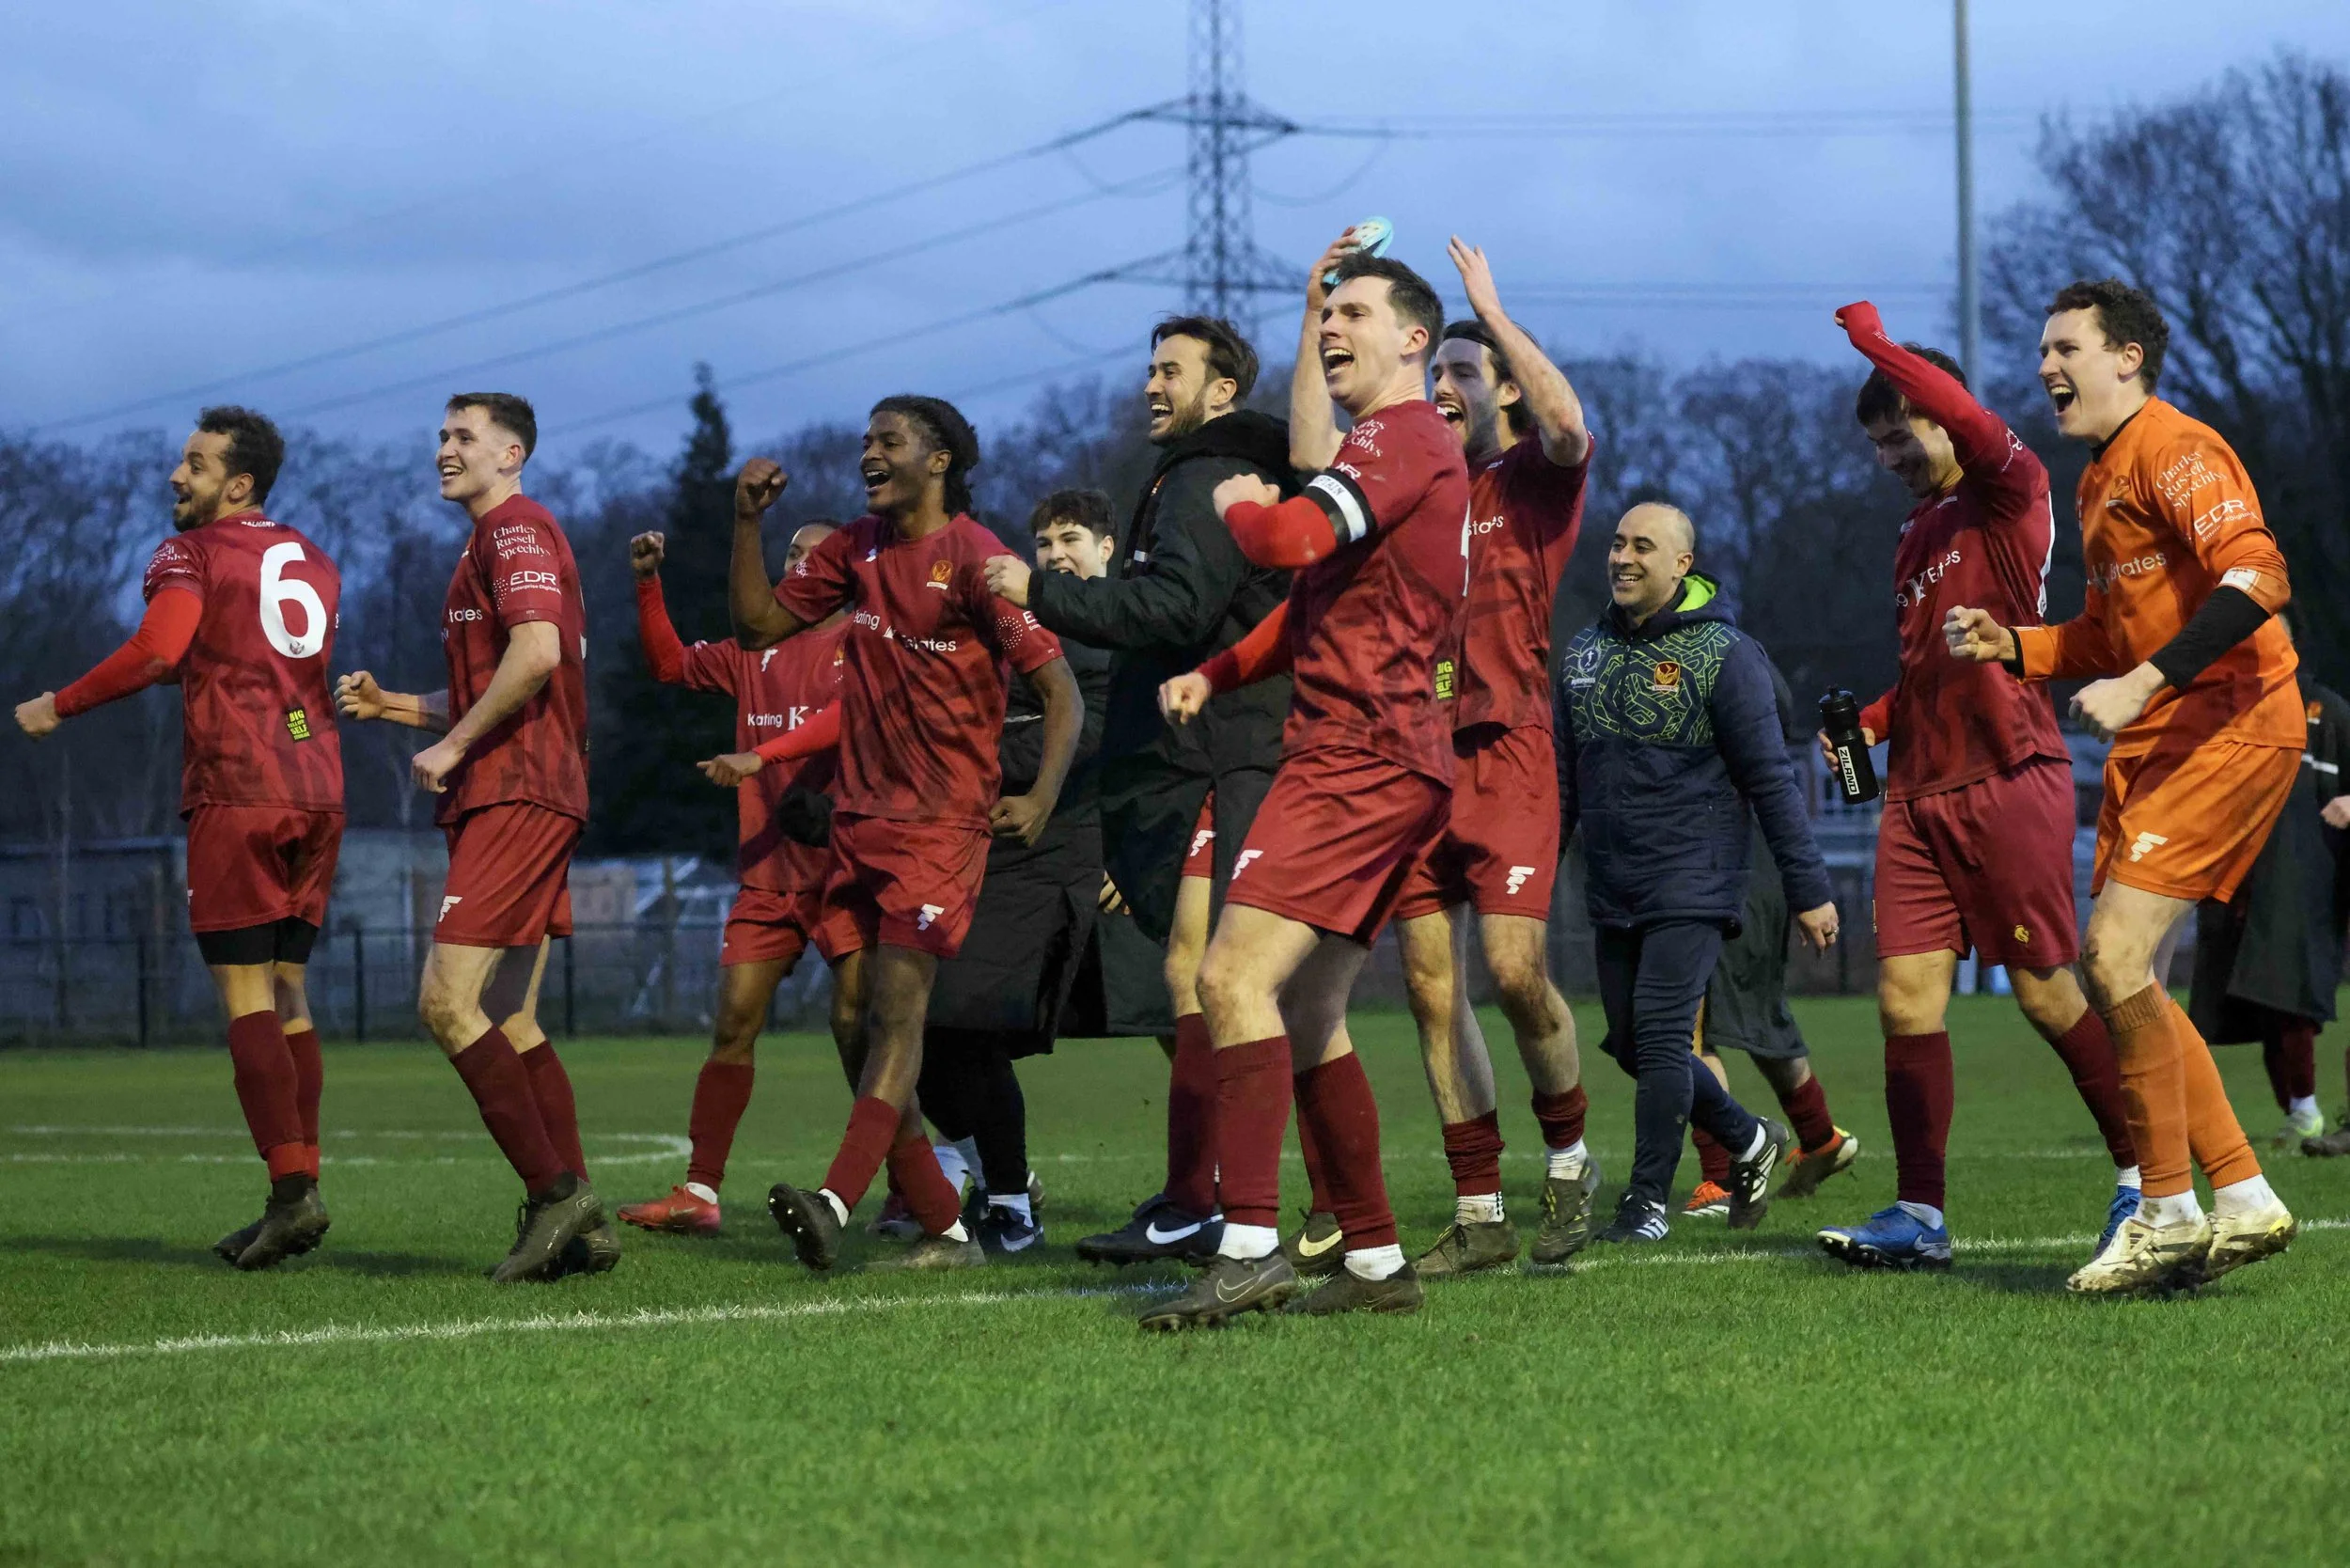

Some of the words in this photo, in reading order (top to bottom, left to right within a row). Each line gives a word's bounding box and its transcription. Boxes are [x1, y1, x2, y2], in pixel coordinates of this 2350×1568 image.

[2156, 451, 2202, 489] Charles
[2194, 499, 2248, 536] EDR
[493, 524, 537, 540] Charles
[495, 534, 536, 550] Russell
[498, 544, 551, 560] Speechlys
[510, 571, 556, 587] EDR
[259, 541, 327, 659] 6
[290, 710, 306, 722] BIG
[1840, 749, 1857, 792] ZILAND
